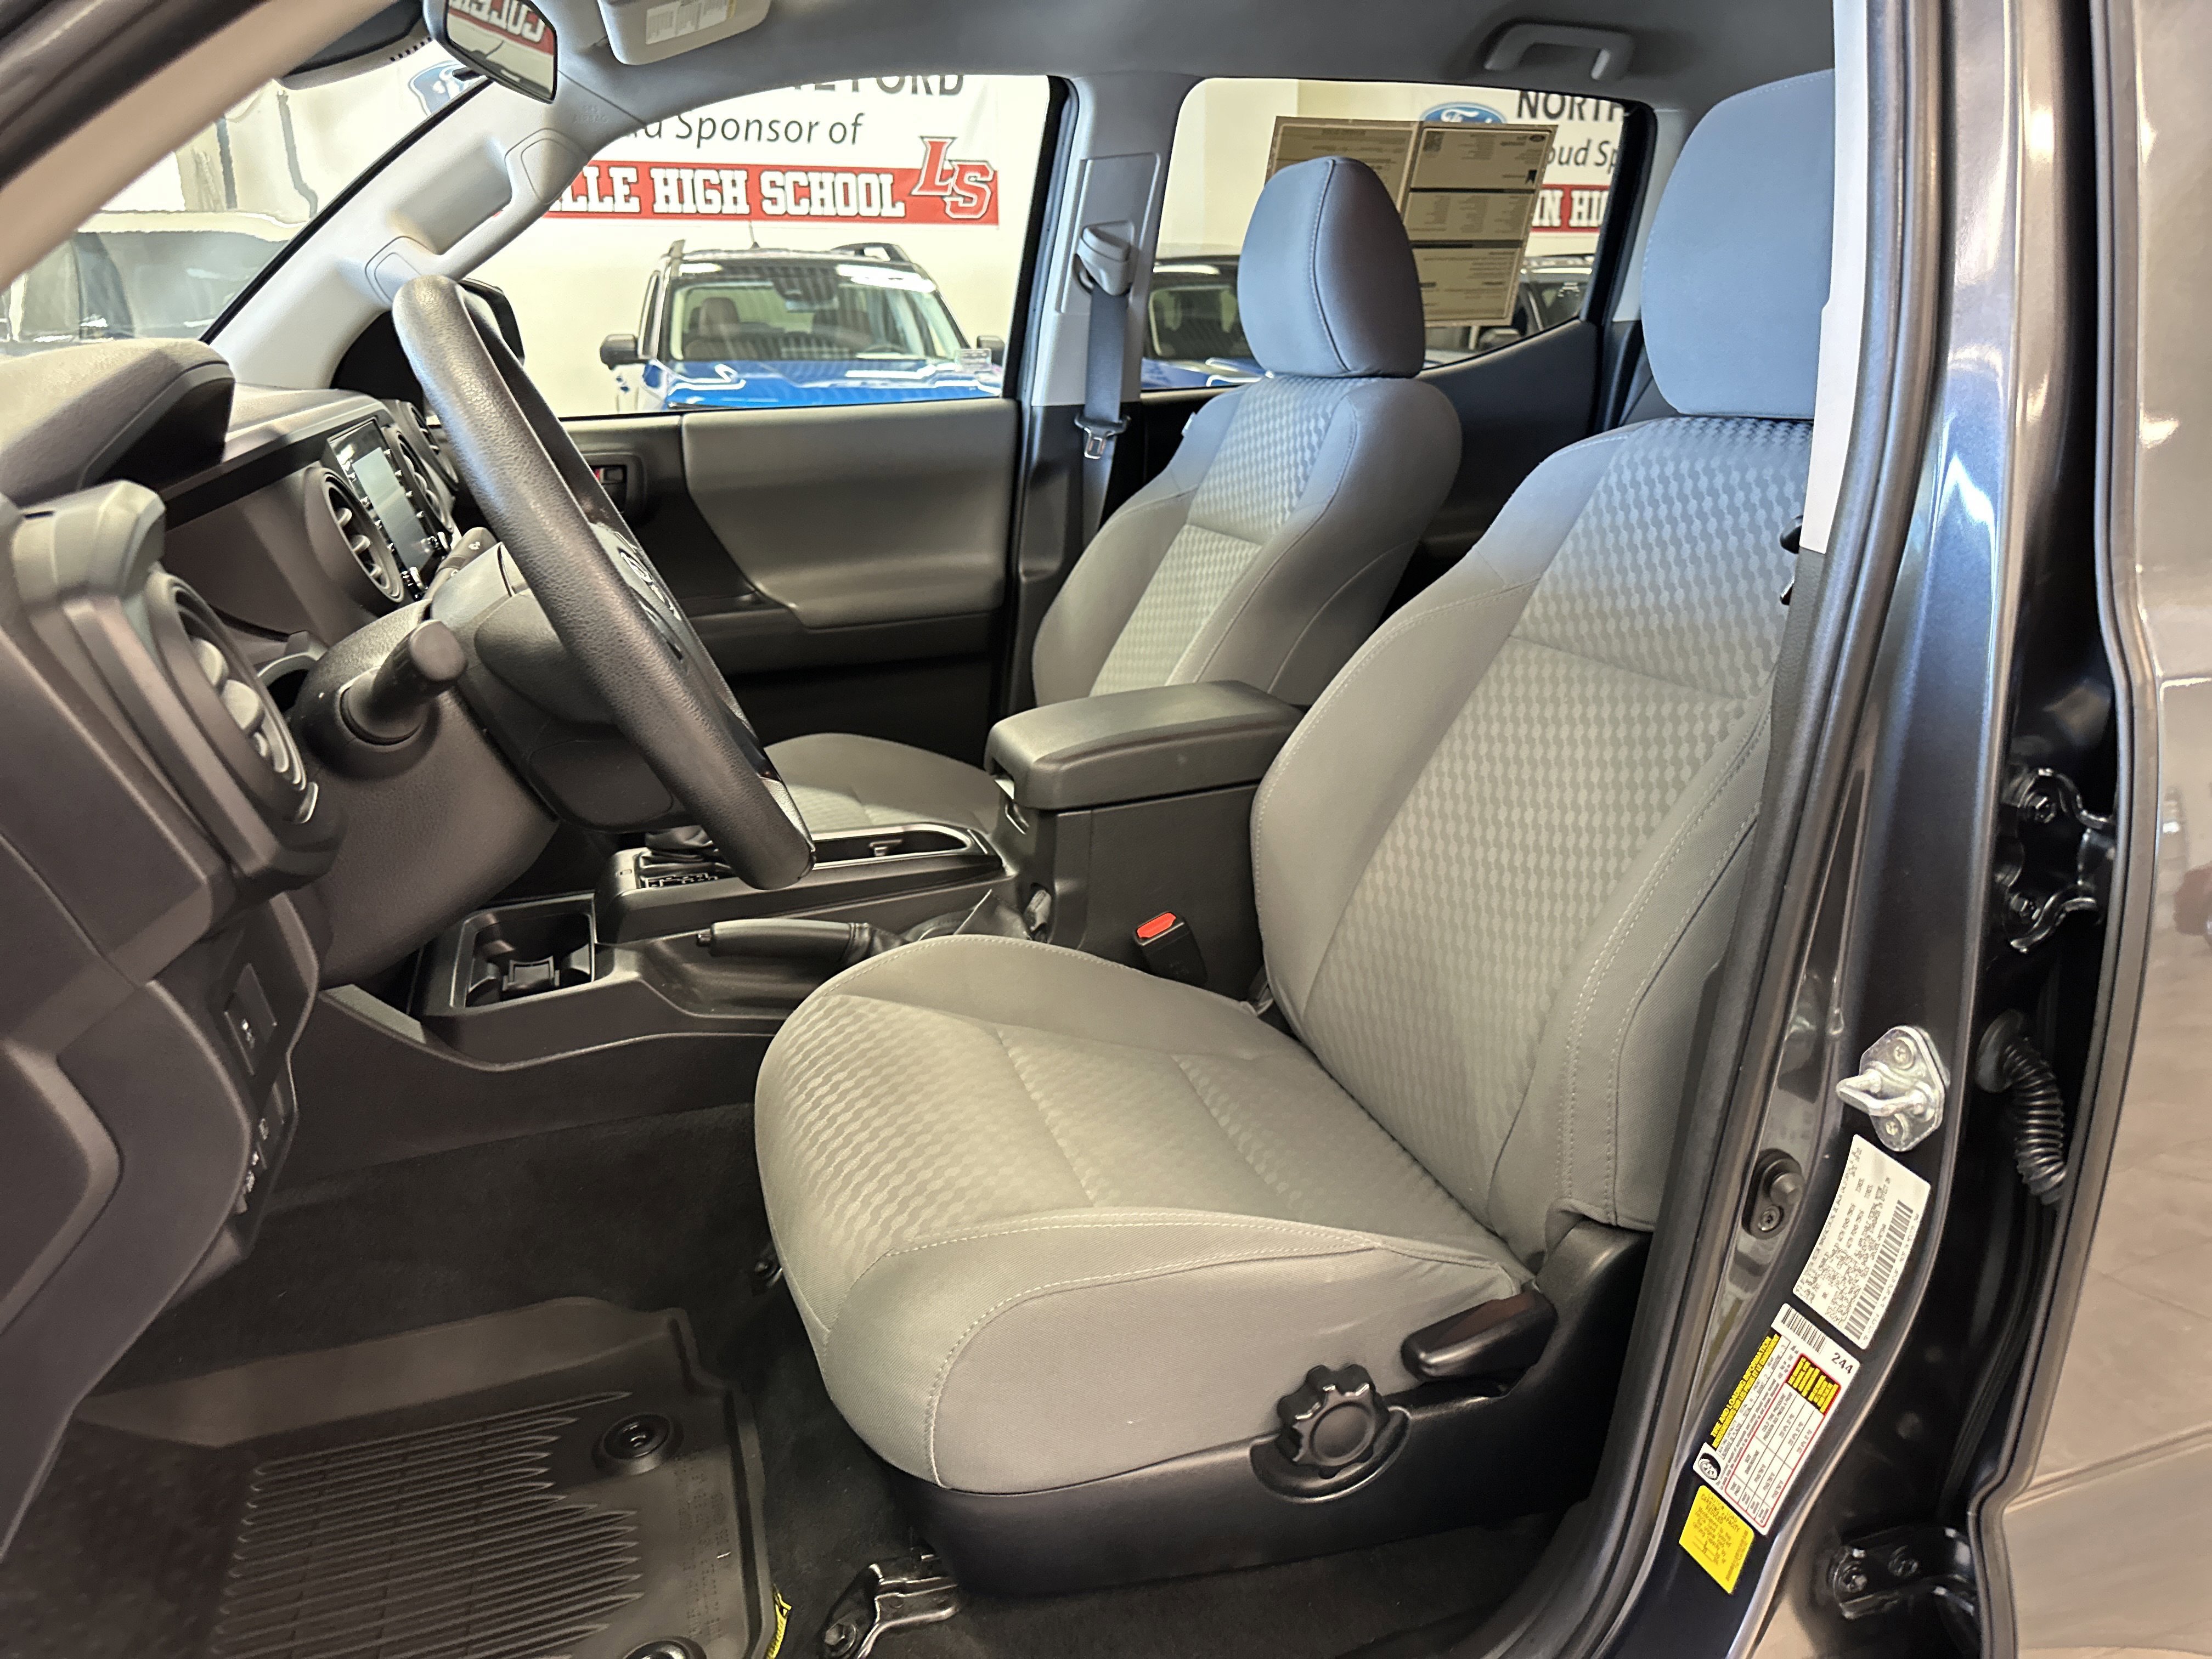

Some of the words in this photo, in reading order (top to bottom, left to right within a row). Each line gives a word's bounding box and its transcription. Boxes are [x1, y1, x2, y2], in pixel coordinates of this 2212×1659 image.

[675, 114, 820, 149] Sponsor
[829, 112, 866, 145] of
[650, 167, 751, 216] HIGH
[759, 171, 906, 218] SCHOOL
[1830, 1351, 1854, 1375] 244
